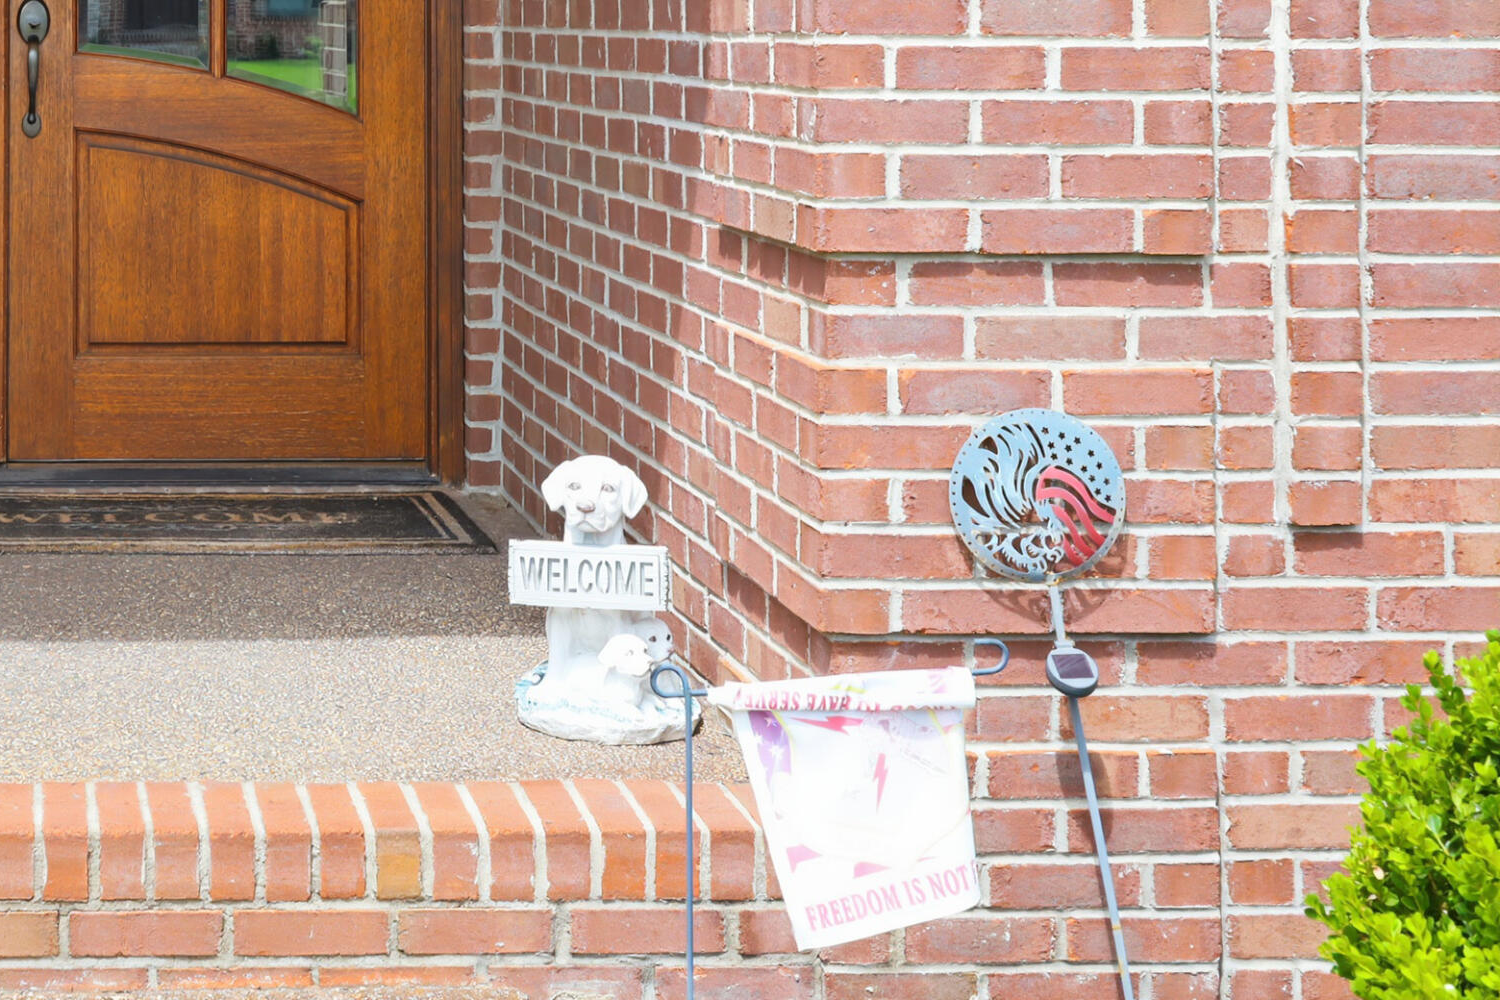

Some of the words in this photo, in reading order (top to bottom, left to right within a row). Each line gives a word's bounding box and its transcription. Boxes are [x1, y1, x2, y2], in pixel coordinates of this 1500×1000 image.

[520, 555, 654, 597] WELCOME
[804, 882, 902, 932] FREEDOM
[902, 877, 927, 906] IS
[927, 864, 971, 900] NOT
